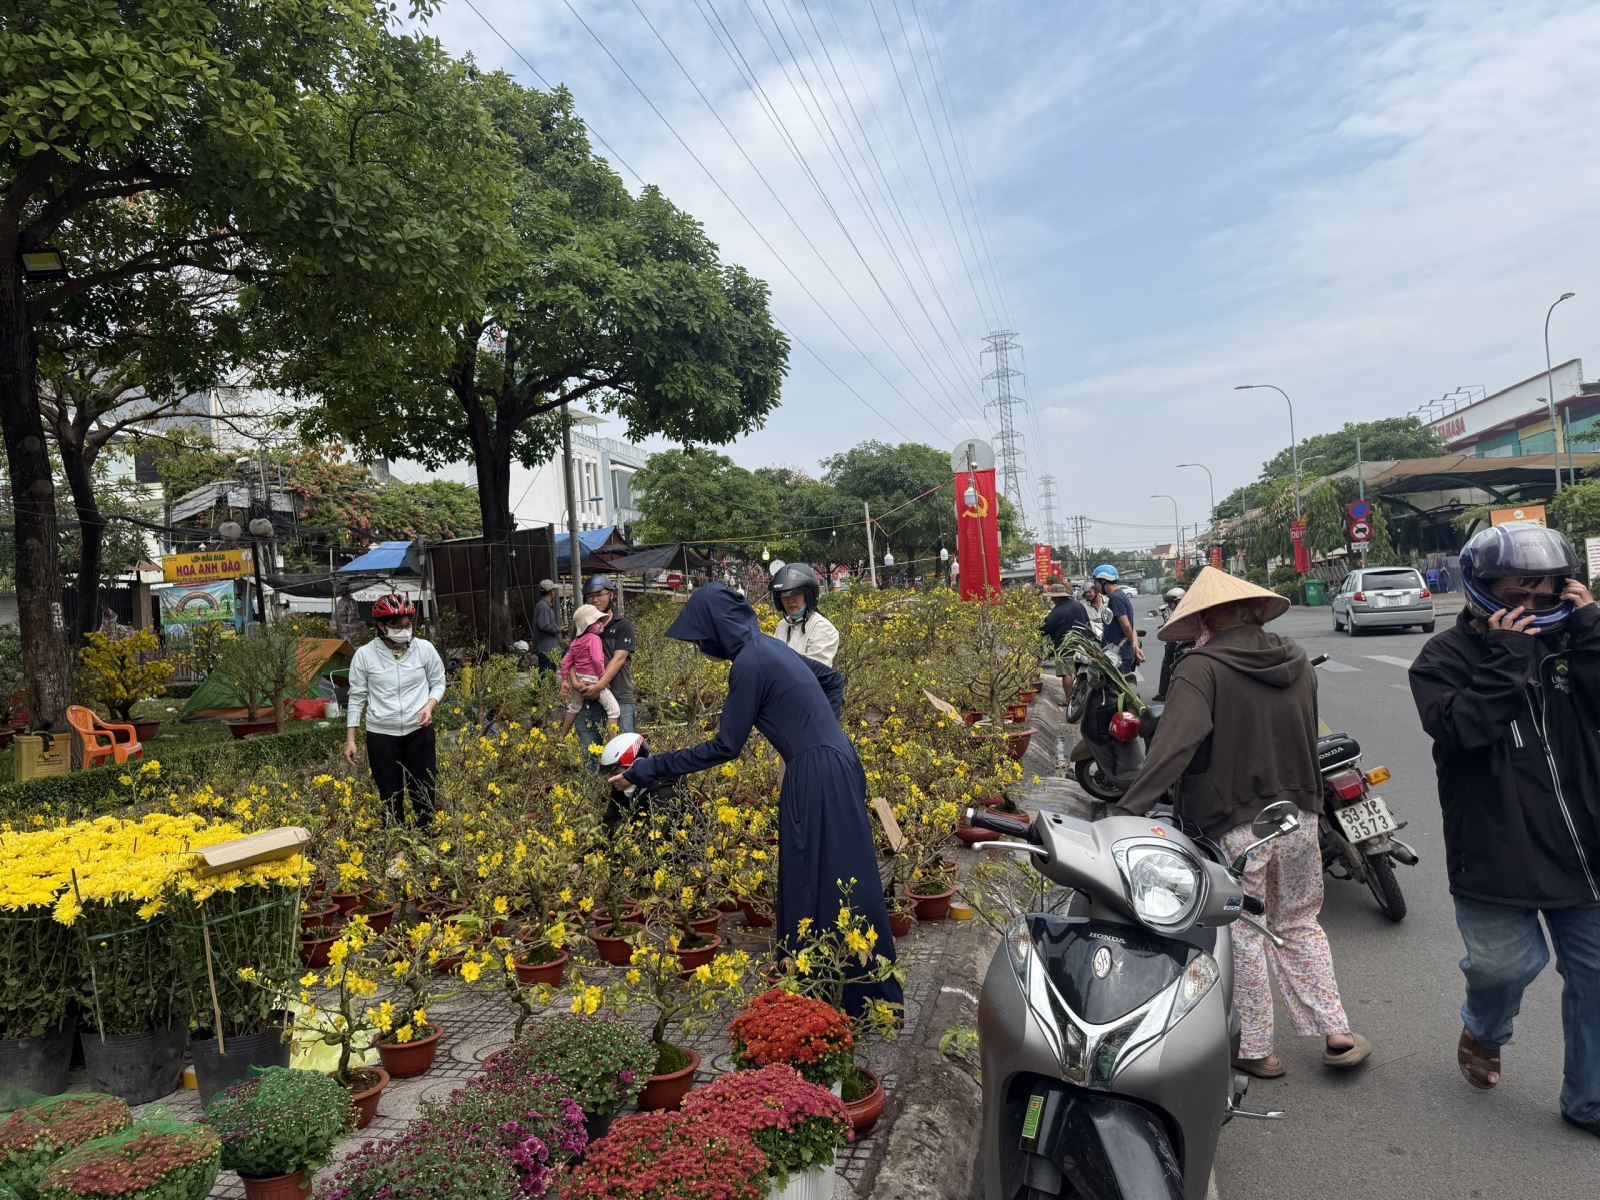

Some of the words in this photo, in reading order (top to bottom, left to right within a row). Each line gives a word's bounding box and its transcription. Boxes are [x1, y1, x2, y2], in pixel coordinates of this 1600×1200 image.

[176, 563, 197, 577] HOA
[199, 562, 218, 575] ANH
[221, 558, 241, 573] ĐÀO
[1319, 746, 1344, 760] ONDA
[1351, 815, 1389, 839] 3573
[1088, 931, 1127, 945] HONDA
